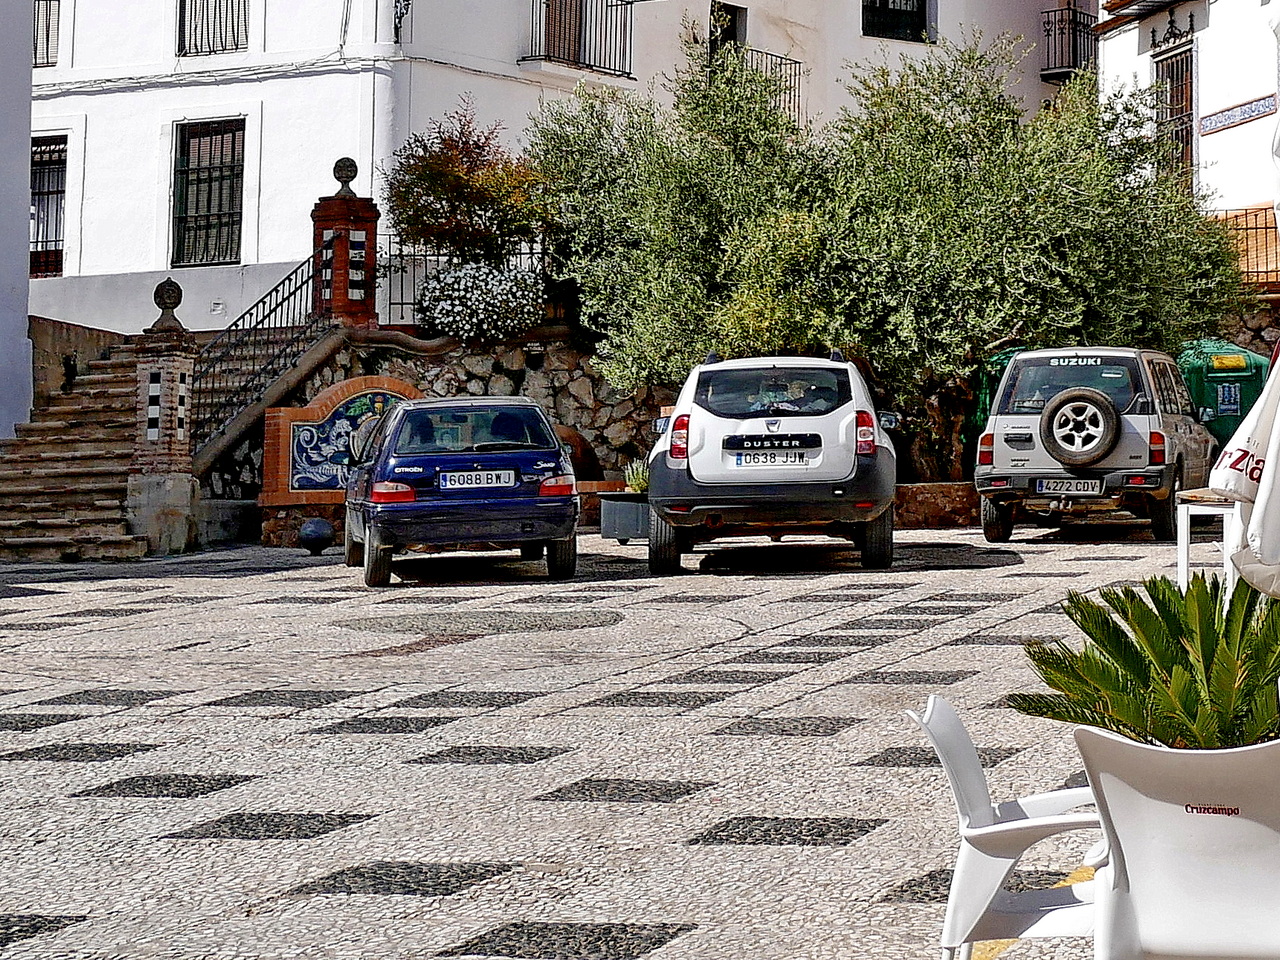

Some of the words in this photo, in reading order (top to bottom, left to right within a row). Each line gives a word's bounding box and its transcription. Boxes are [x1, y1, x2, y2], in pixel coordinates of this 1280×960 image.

[1050, 358, 1102, 366] SUZUKI
[744, 452, 777, 465] 0638
[449, 473, 482, 486] 6088
[486, 472, 512, 485] BWJ
[1044, 480, 1073, 492] 4272
[1075, 481, 1097, 492] CDV
[1184, 803, 1240, 817] Cruzcampo
